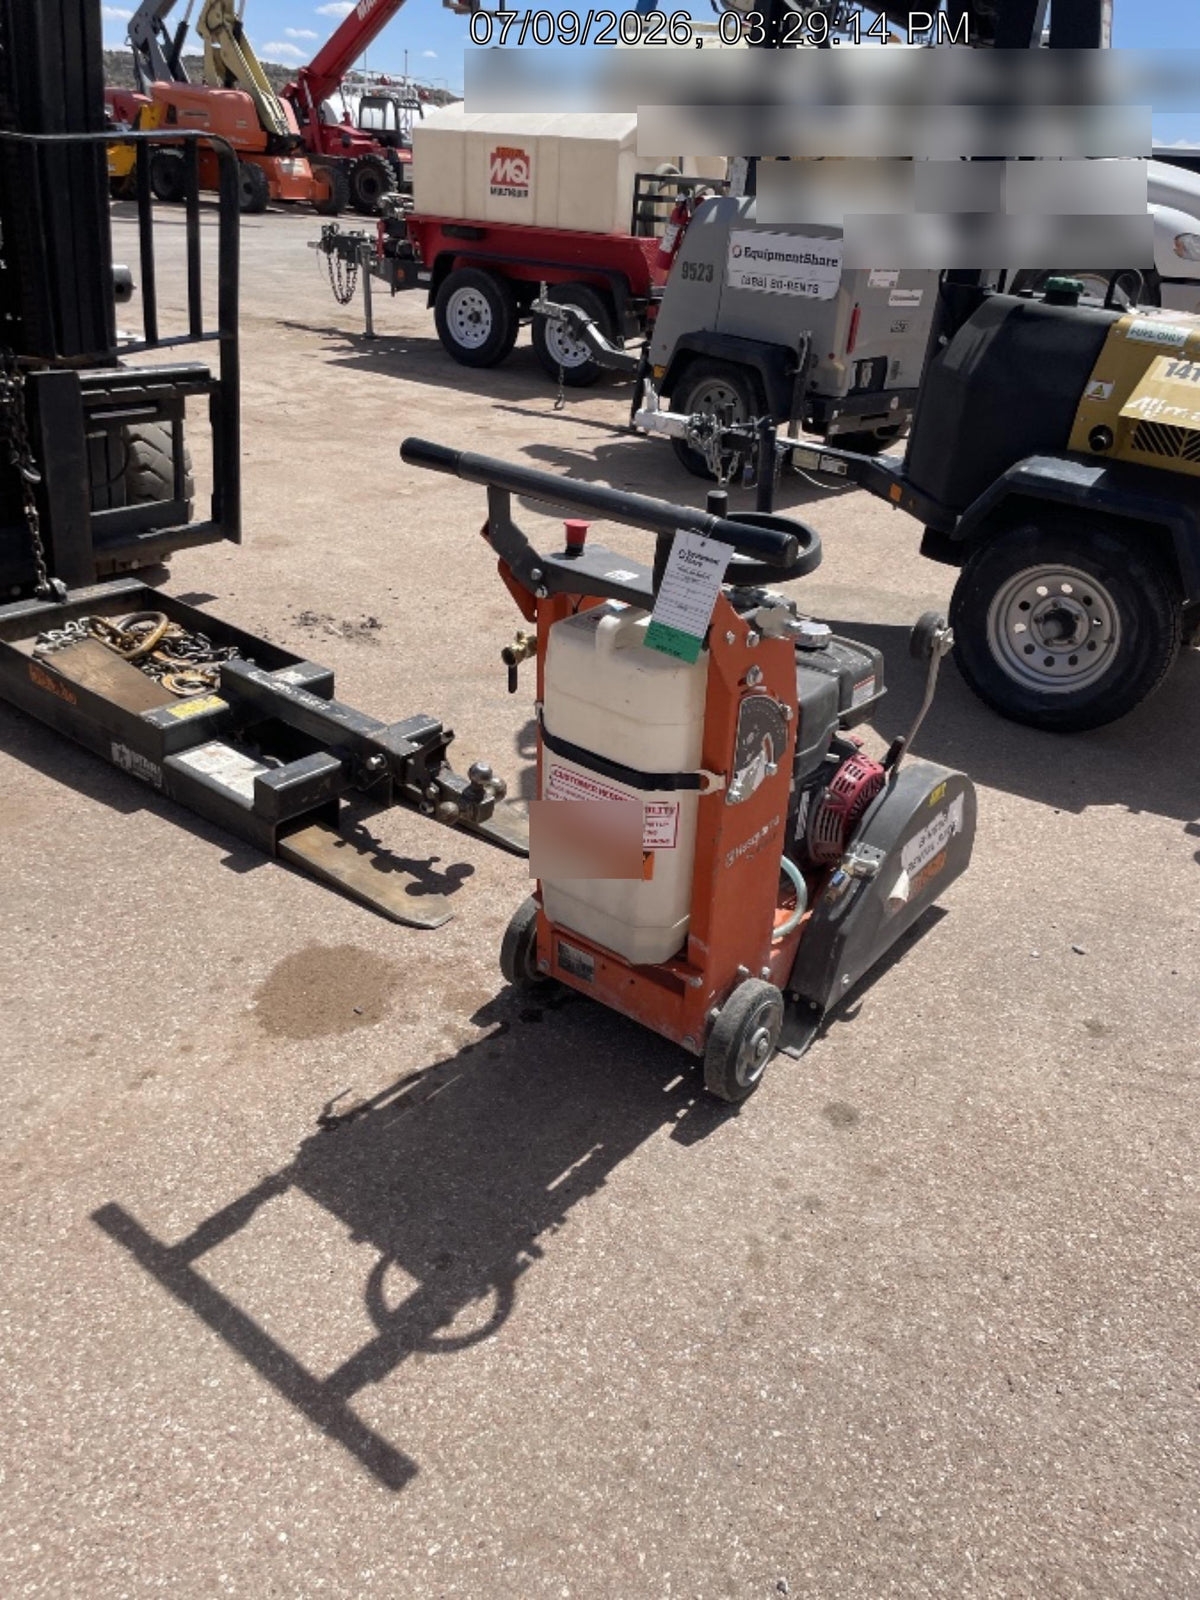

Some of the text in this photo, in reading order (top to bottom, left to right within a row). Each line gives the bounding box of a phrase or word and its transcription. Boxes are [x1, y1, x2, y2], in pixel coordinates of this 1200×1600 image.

[490, 158, 529, 184] MQ
[744, 246, 839, 268] EquipmentShare
[681, 261, 714, 283] 9523
[1156, 332, 1184, 343] ONLY
[553, 768, 598, 793] CUSTOMER
